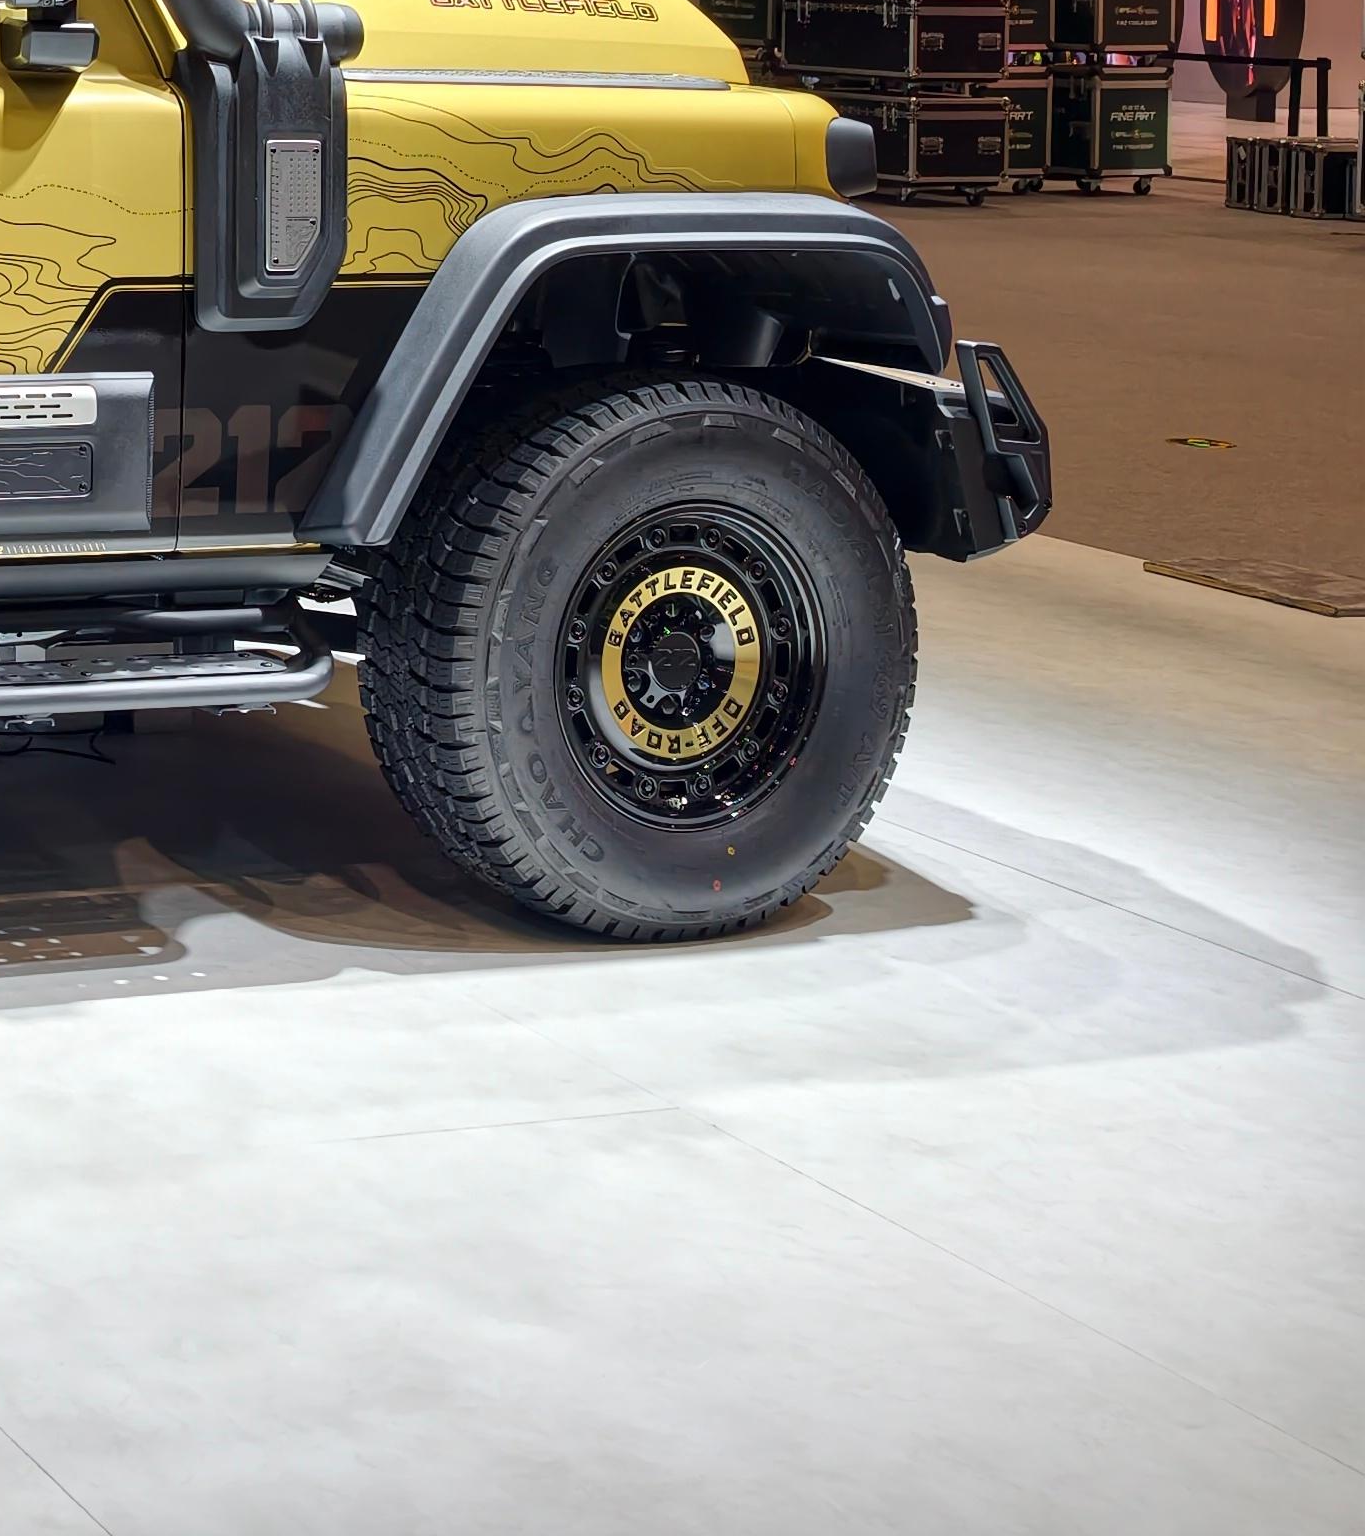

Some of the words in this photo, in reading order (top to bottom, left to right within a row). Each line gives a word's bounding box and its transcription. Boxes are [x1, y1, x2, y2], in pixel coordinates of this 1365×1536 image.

[1110, 111, 1133, 122] FINE
[1134, 111, 1156, 121] ART
[145, 404, 354, 518] 212
[607, 569, 755, 648] BATTLEFIELD
[613, 695, 744, 755] OFF-ROAD
